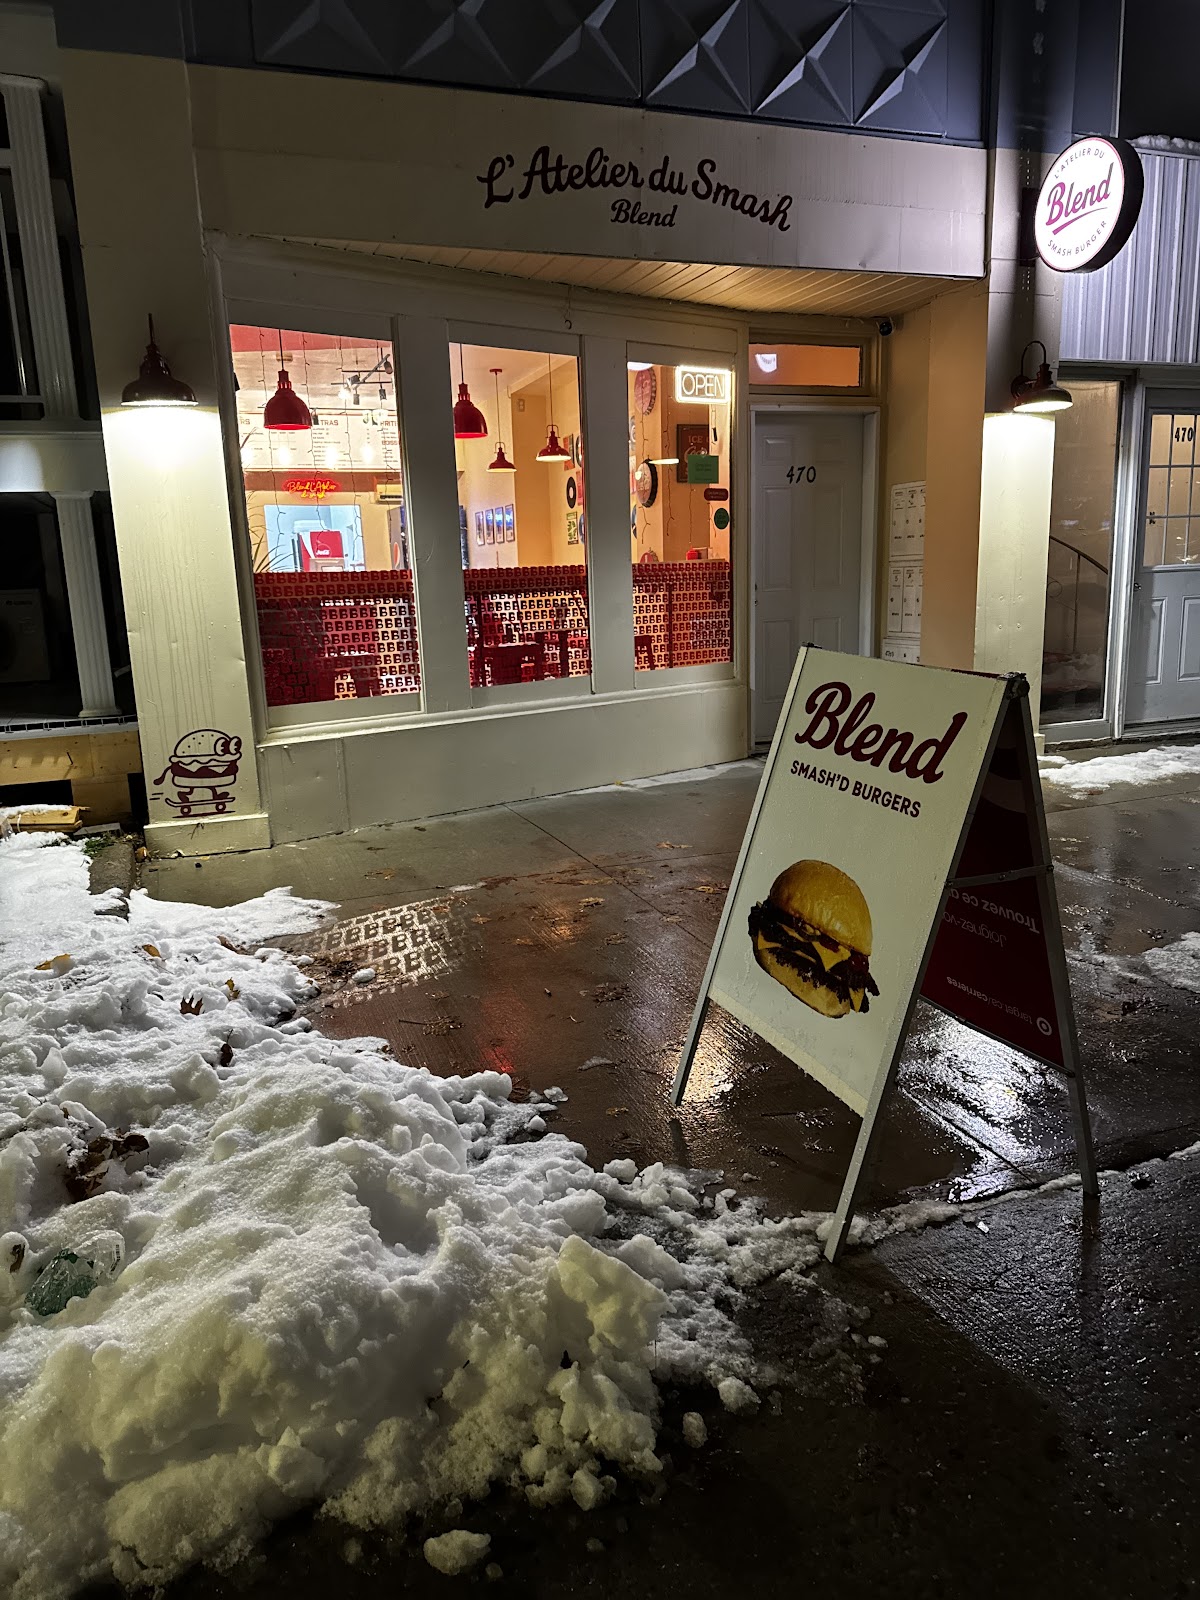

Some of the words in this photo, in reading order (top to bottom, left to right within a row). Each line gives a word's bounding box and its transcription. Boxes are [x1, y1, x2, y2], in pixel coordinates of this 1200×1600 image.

[1093, 147, 1105, 159] DU
[648, 155, 688, 195] du
[691, 159, 793, 232] Smash
[1045, 161, 1114, 226] Blend
[610, 199, 678, 228] Blend
[1047, 239, 1072, 256] SMASH
[1074, 220, 1107, 255] BURGER
[682, 373, 724, 396] OPEN
[688, 435, 703, 443] ICE
[1174, 427, 1194, 443] 470
[786, 465, 817, 485] 470
[794, 681, 969, 784] Blend
[790, 759, 850, 792] SMASH'D
[851, 780, 922, 818] BURGERS
[961, 891, 979, 907] ce
[982, 899, 1040, 934] Trouvez
